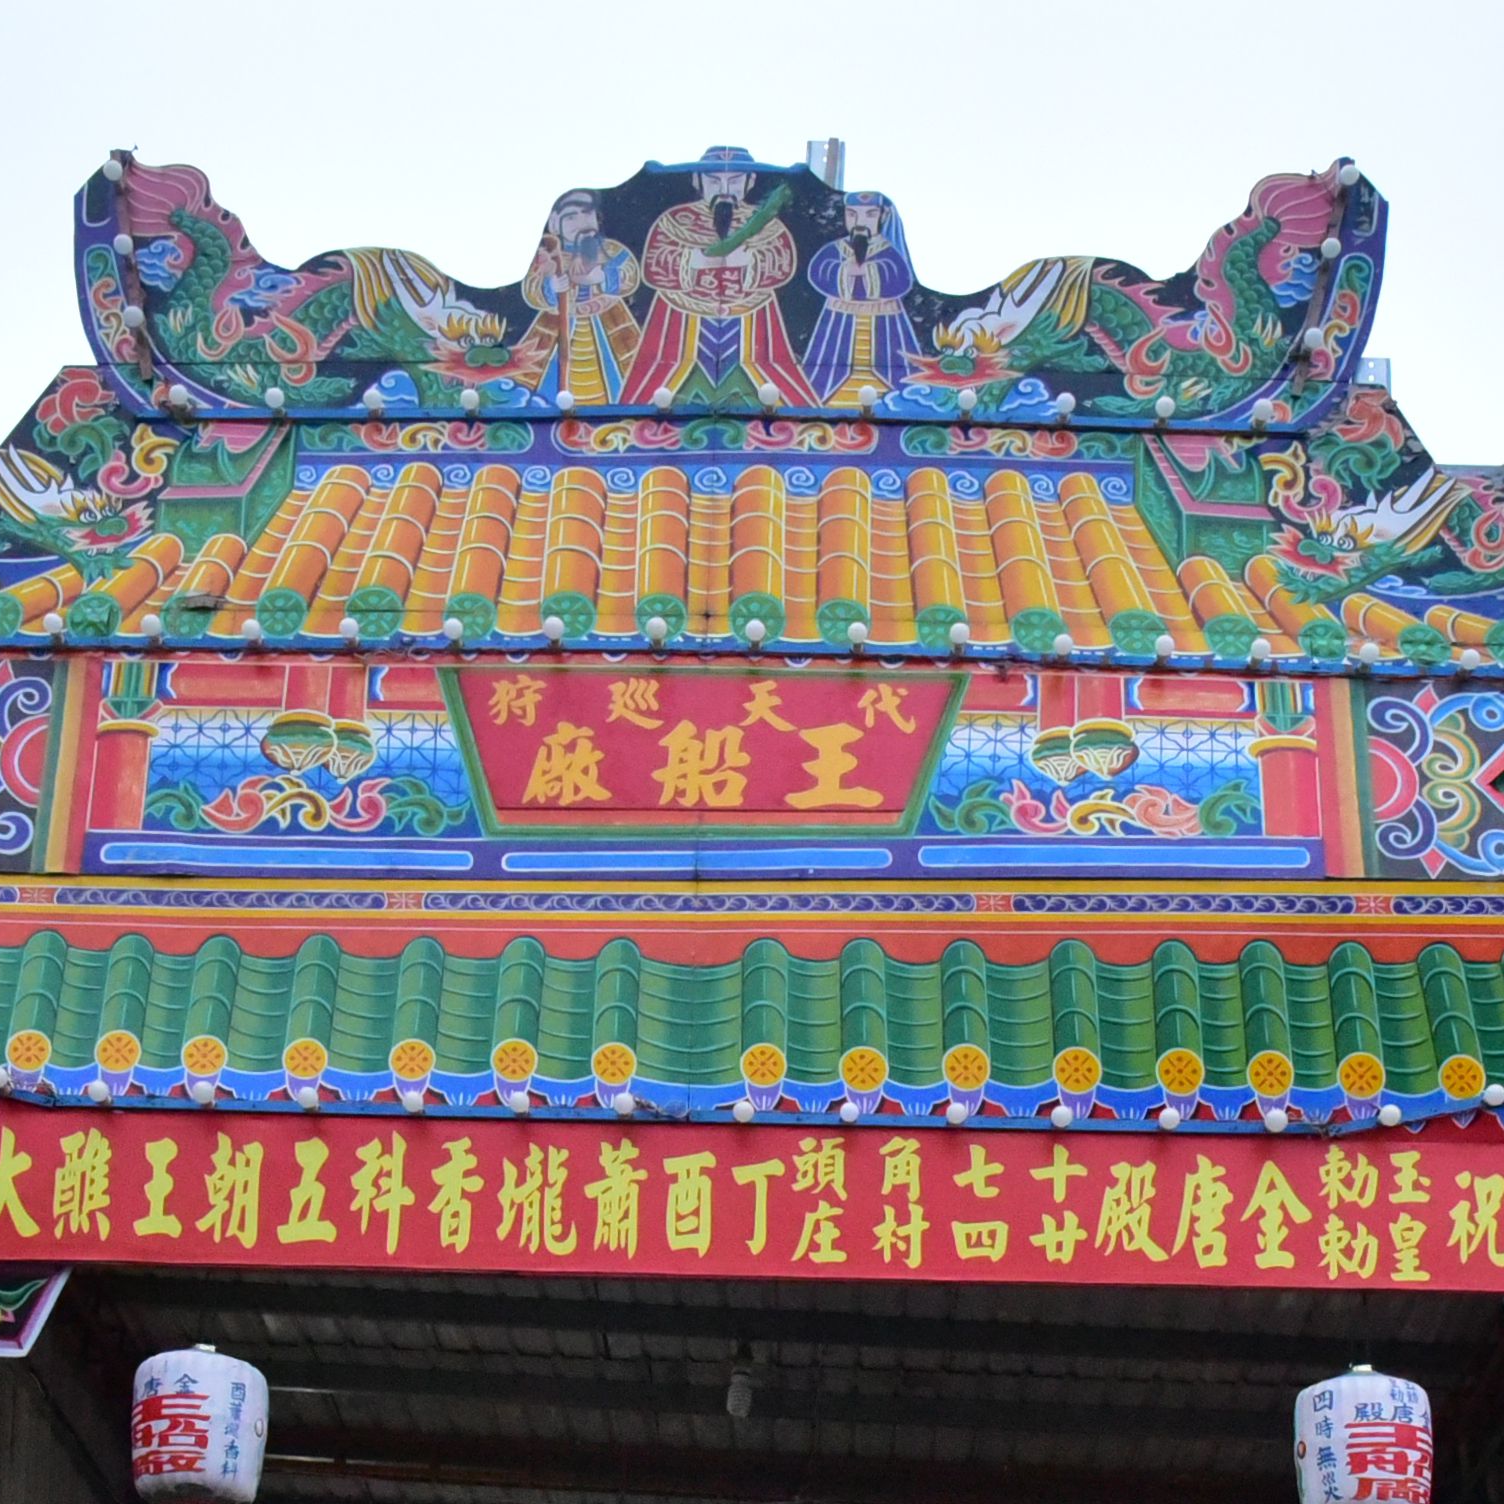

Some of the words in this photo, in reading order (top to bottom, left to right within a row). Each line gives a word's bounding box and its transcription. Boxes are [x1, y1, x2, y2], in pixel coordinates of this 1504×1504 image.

[488, 674, 915, 734] 代天巡狩
[521, 719, 885, 809] 王船廠
